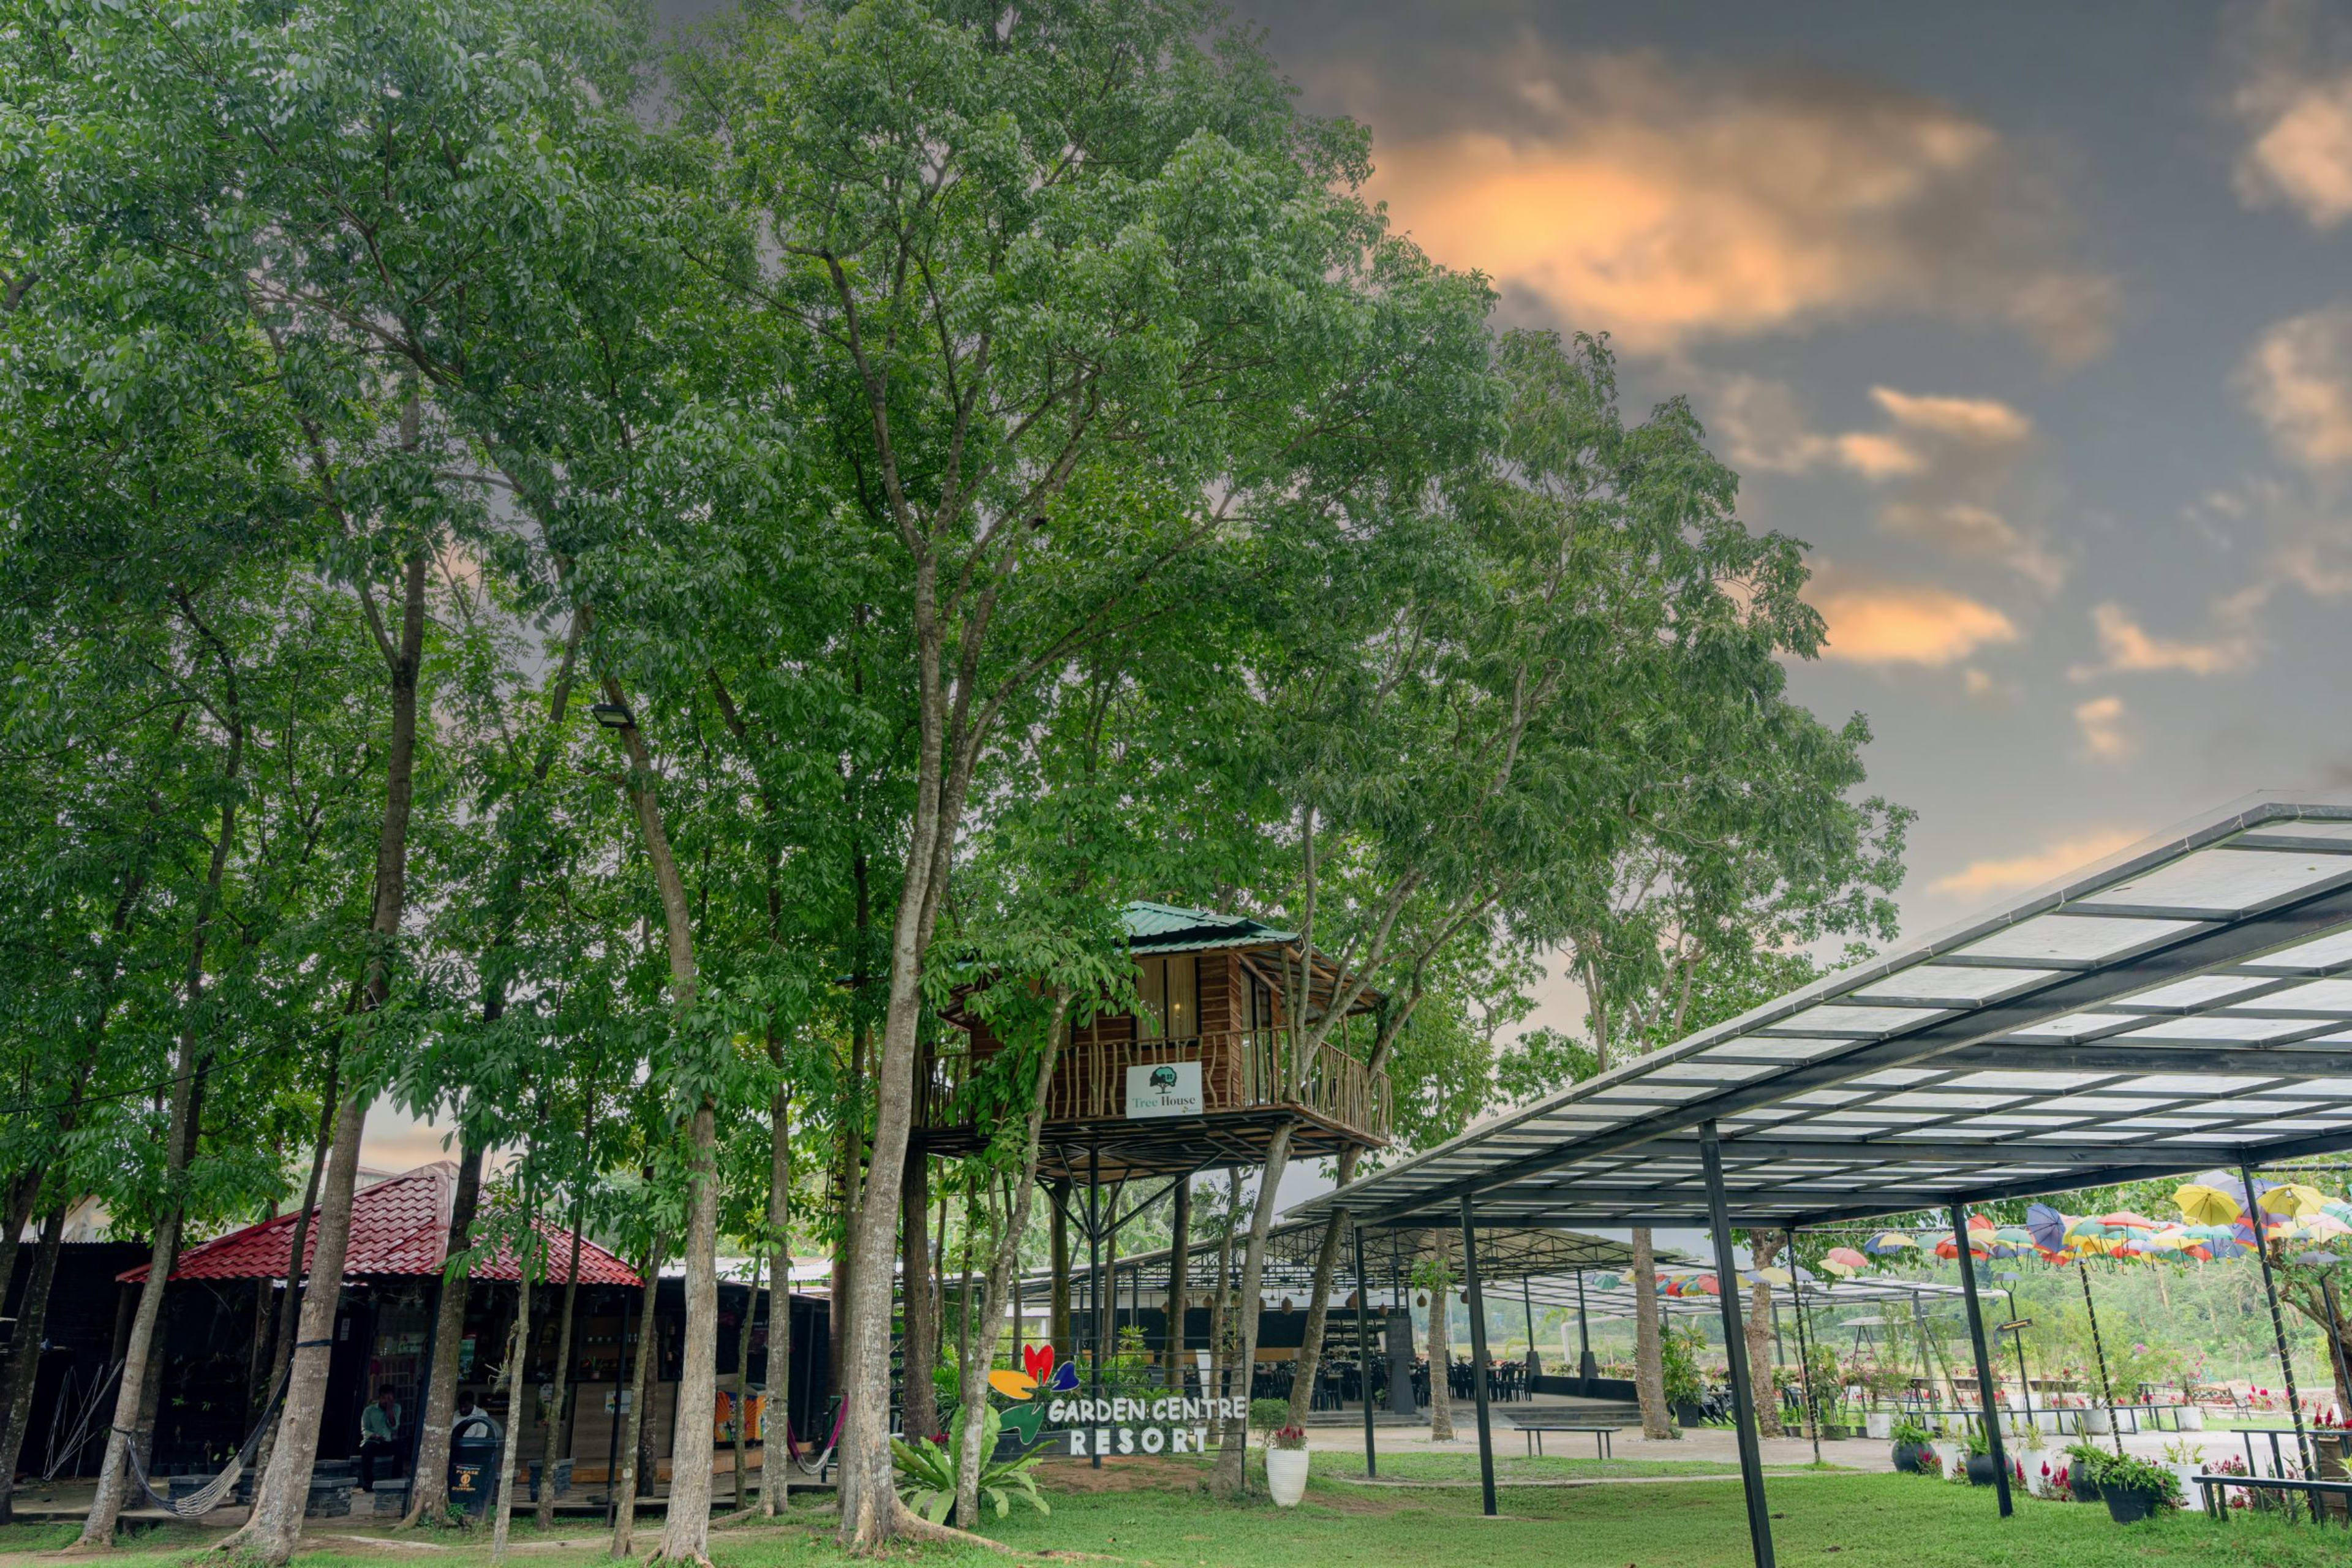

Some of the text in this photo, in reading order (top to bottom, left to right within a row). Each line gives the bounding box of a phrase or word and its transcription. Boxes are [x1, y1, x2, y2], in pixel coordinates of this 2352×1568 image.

[1132, 1096, 1196, 1108] Tree House
[1048, 1396, 1246, 1422] GARDEN CENTRE
[1069, 1427, 1208, 1456] RESORT
